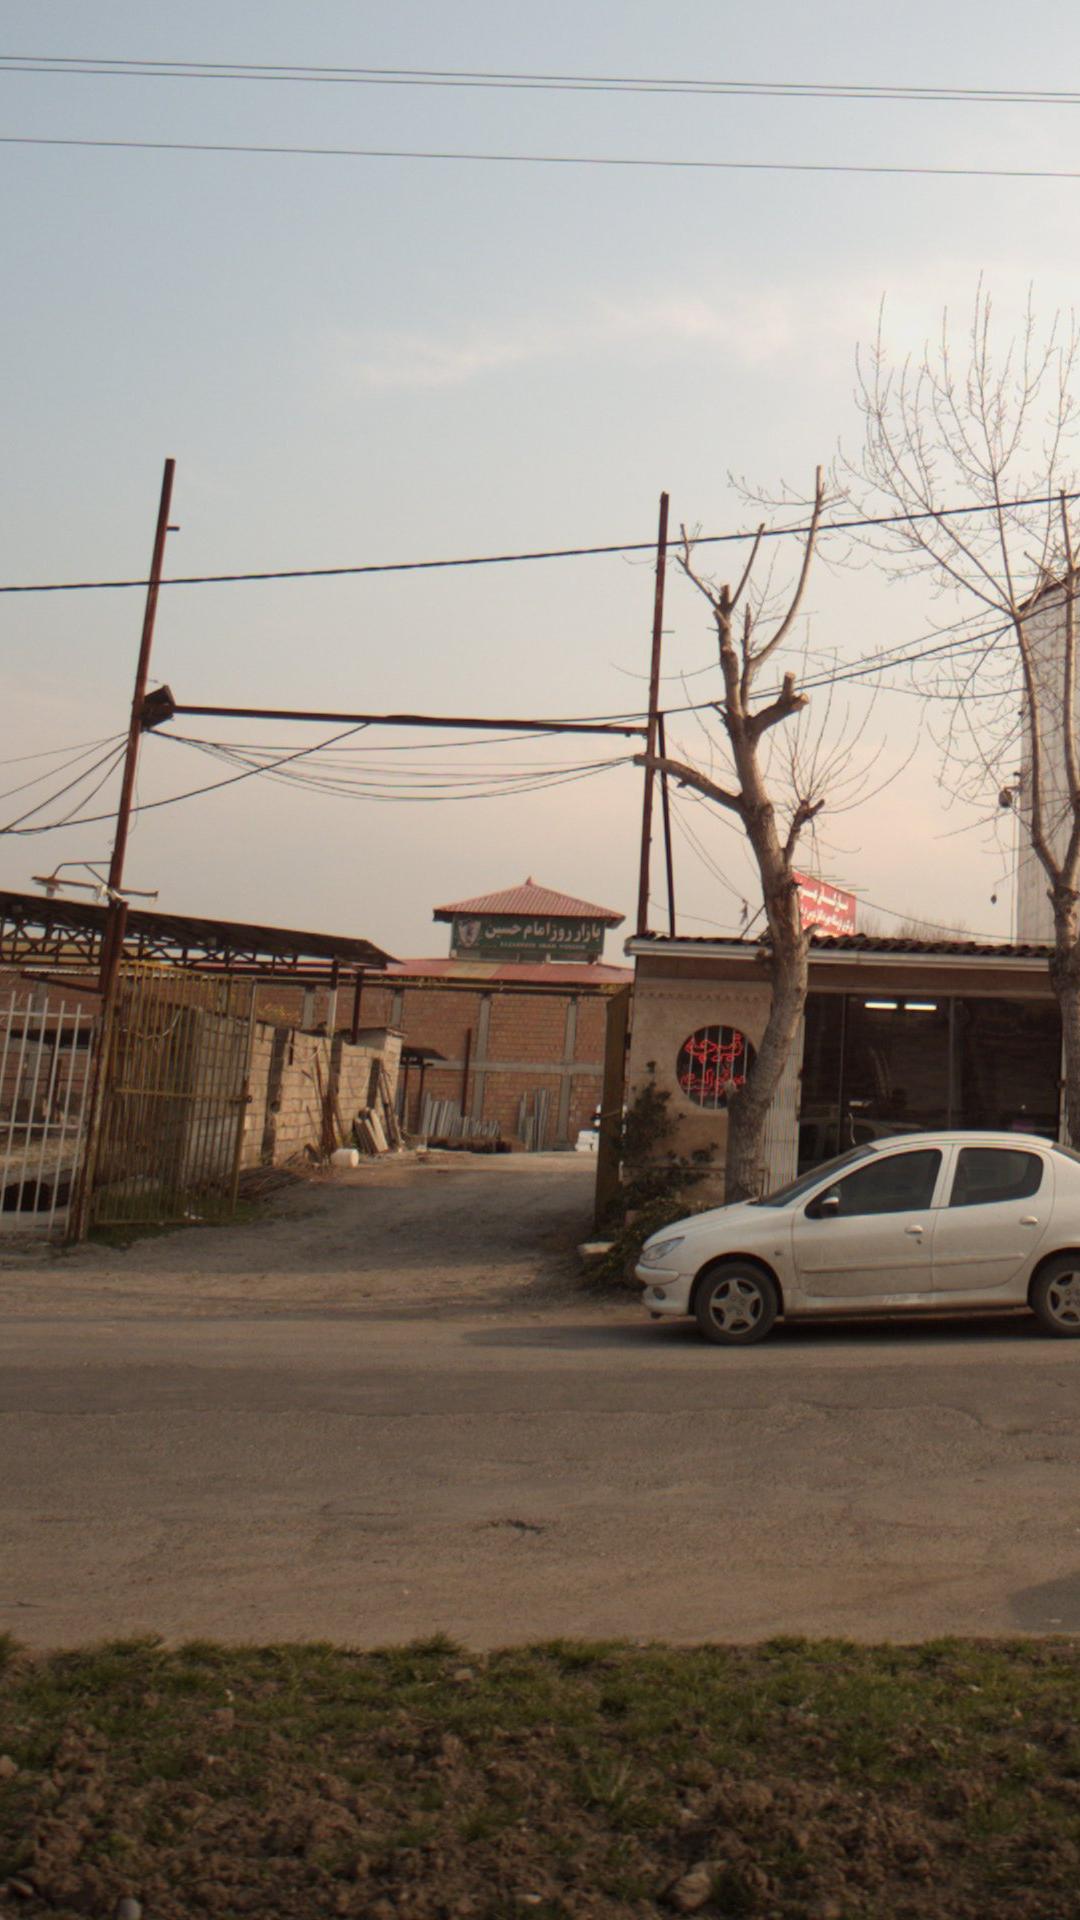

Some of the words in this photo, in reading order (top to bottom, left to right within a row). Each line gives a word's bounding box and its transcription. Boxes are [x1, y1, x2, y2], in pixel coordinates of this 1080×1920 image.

[484, 924, 522, 939] حسین
[523, 921, 551, 939] امام
[550, 924, 573, 942] روز
[573, 922, 601, 942] بازار
